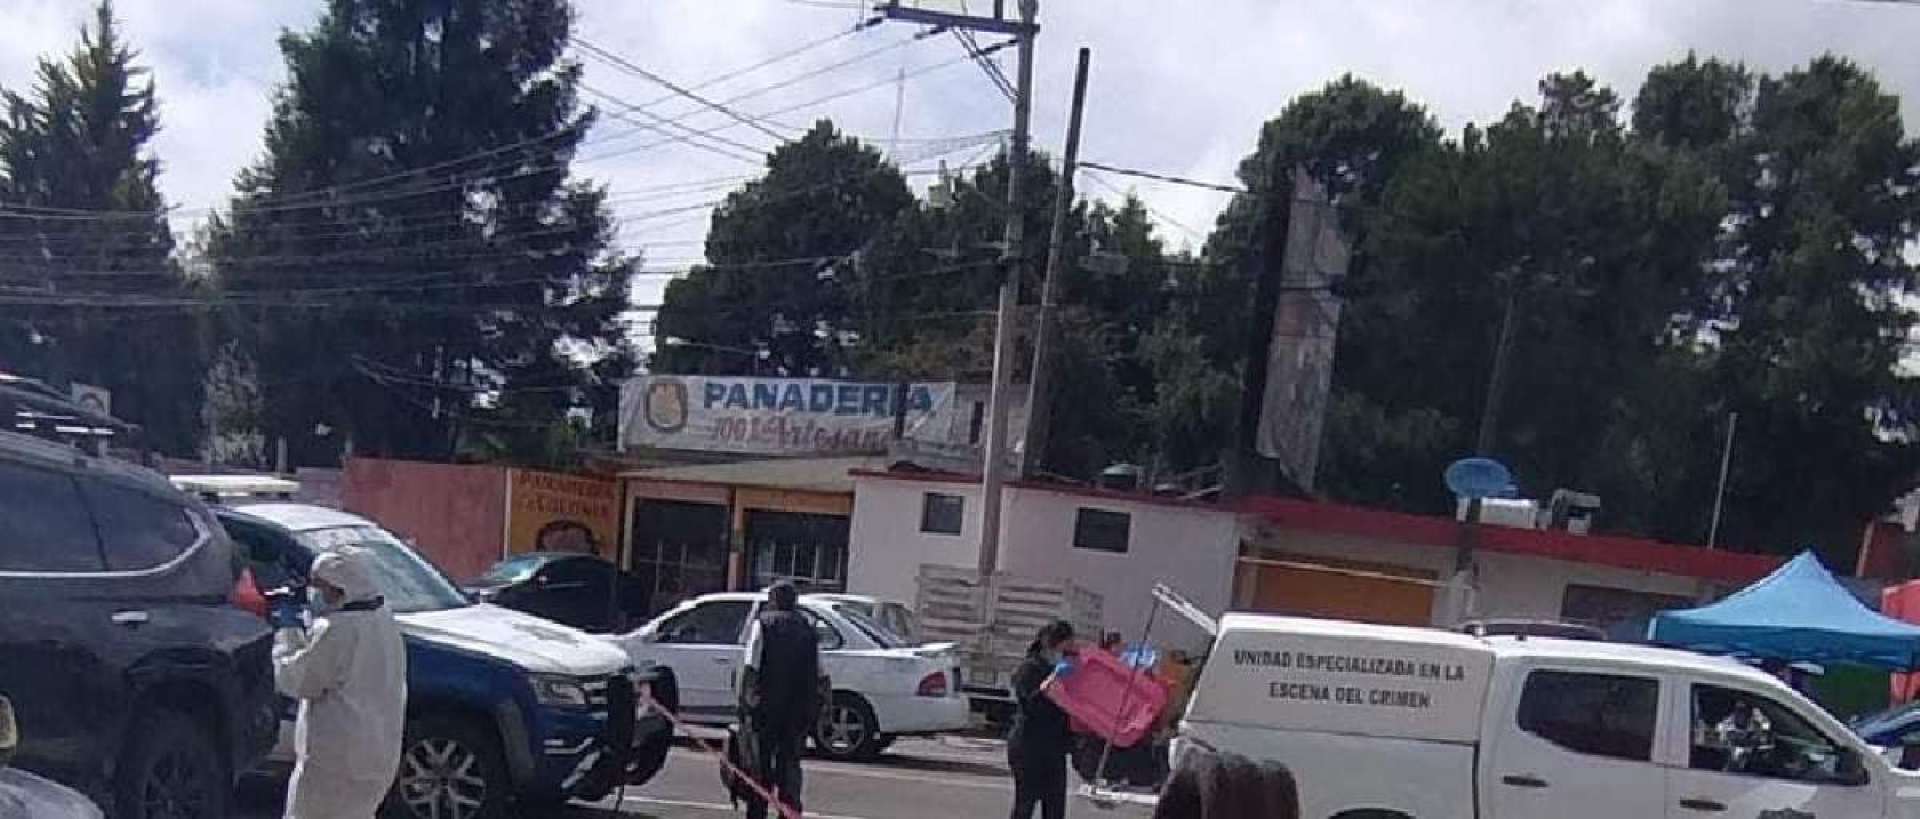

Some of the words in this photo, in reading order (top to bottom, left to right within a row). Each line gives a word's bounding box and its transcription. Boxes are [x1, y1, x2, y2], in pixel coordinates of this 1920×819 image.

[1233, 650, 1291, 668] UNIDAD
[1297, 654, 1415, 677] ESPECIALIZADA
[1419, 661, 1441, 680] EN
[1446, 664, 1464, 681] LA
[1269, 682, 1331, 701] ESCENA
[1336, 687, 1363, 705] DEL
[1369, 688, 1431, 708] CRIMEN
